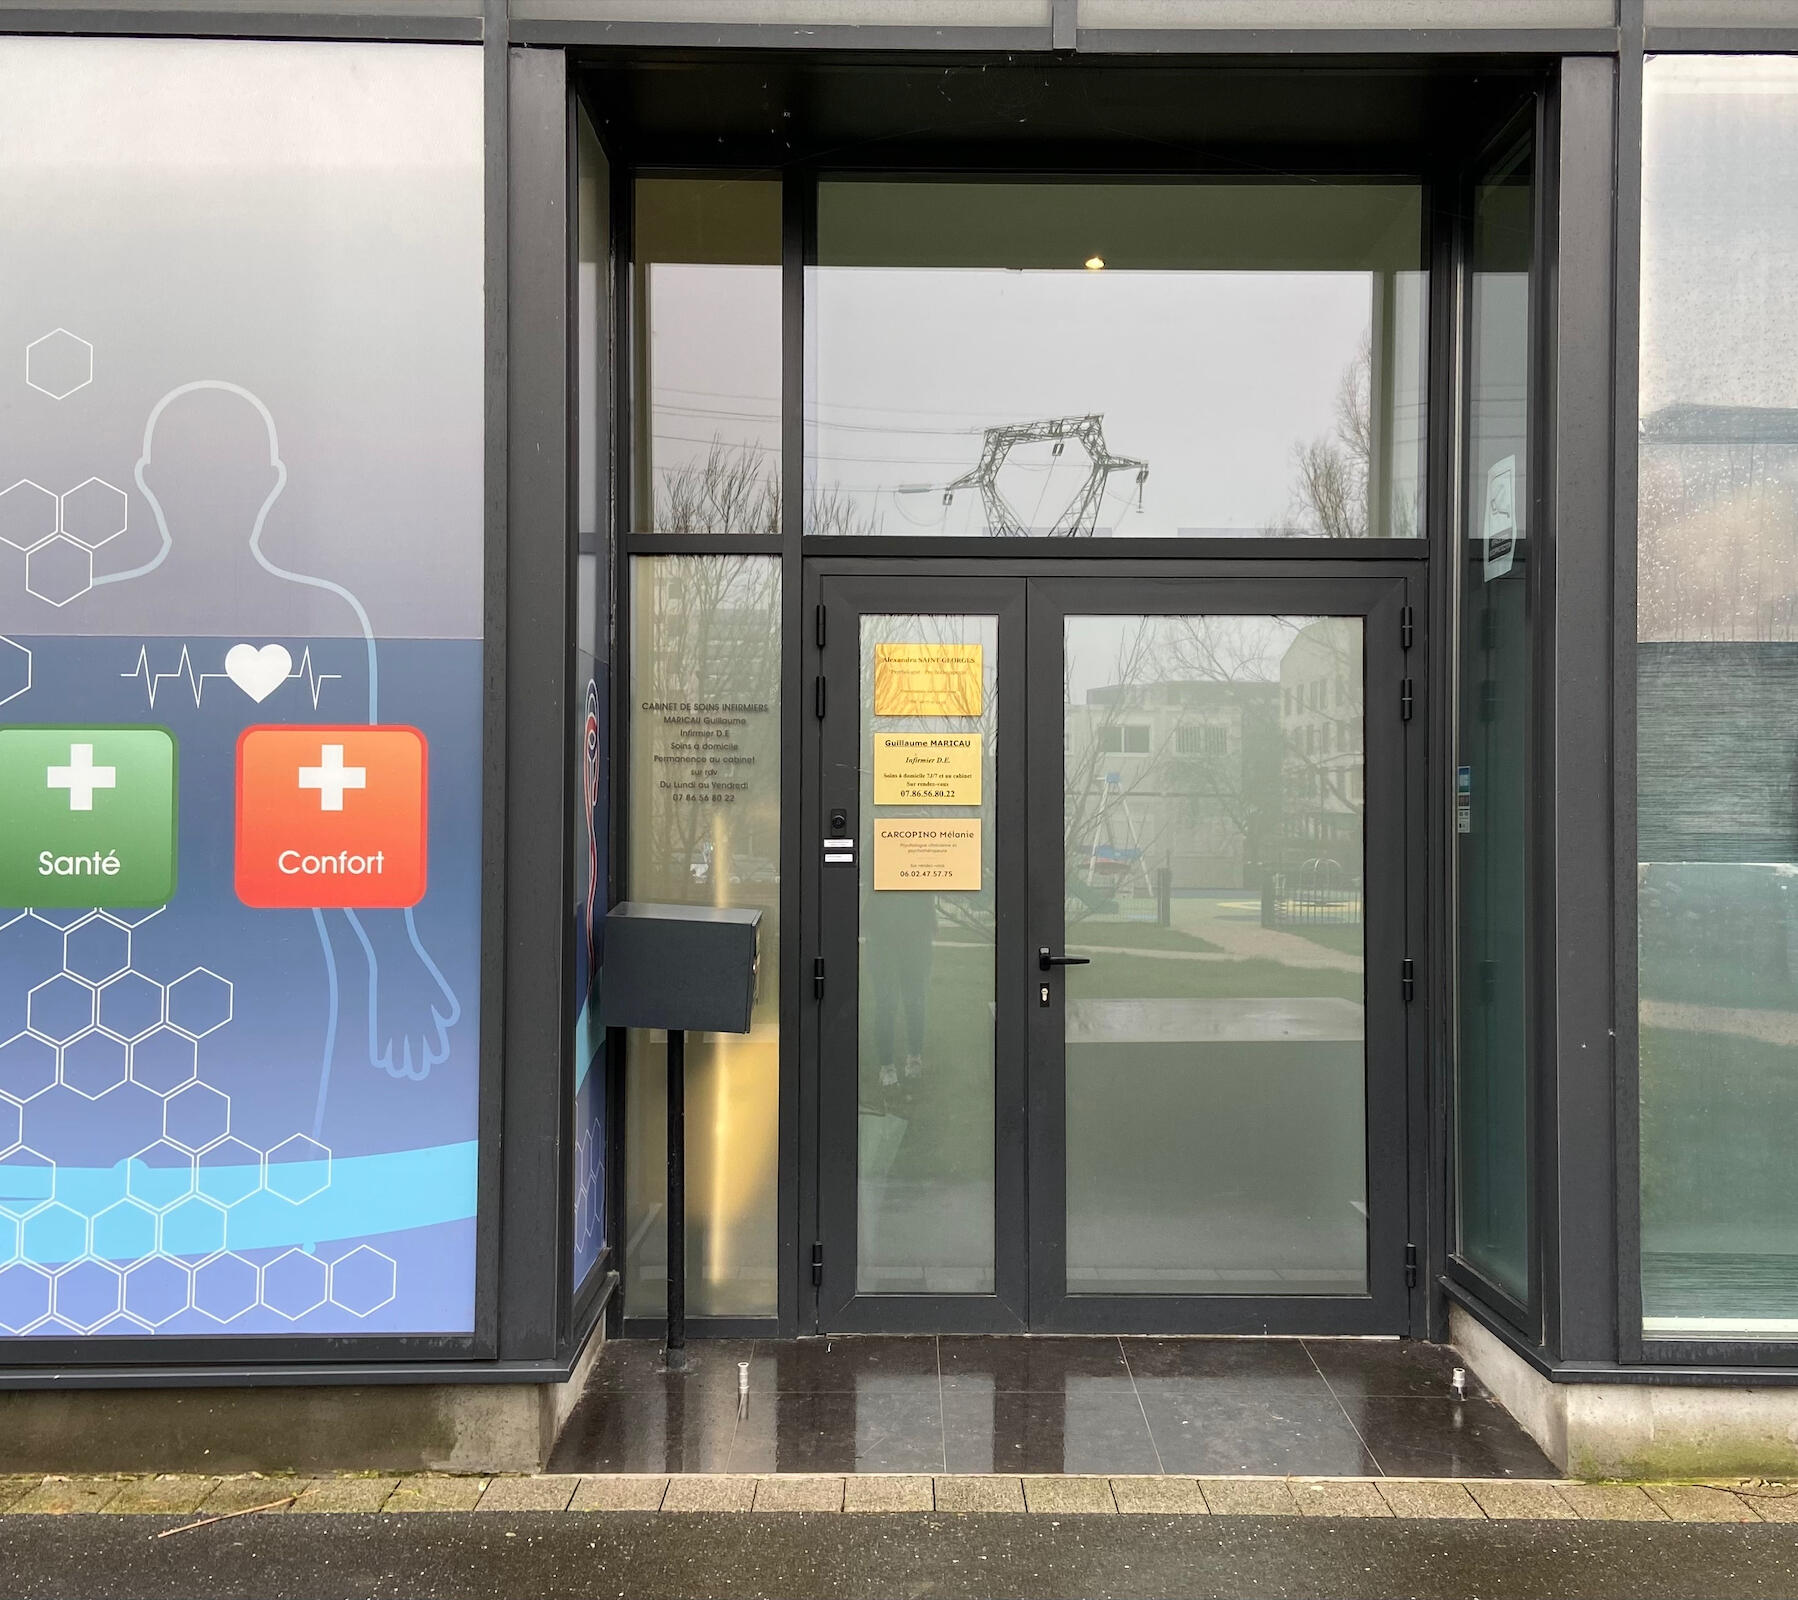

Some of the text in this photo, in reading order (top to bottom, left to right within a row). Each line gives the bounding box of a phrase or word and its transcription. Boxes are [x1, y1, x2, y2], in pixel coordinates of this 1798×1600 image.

[642, 702, 769, 712] CABINET DE SOINS INFIRMIERS
[663, 716, 746, 725] MARICAU Guillaume
[680, 729, 714, 737] Infirmier
[670, 742, 692, 750] Soins
[884, 739, 928, 747] Guillaume
[654, 754, 756, 764] Permanence au cabinet
[905, 756, 935, 764] Infirmier
[704, 768, 718, 776] rdv
[660, 781, 672, 789] Du
[711, 782, 749, 790] Vendredi
[672, 794, 736, 802] 07 86 56 80 22
[900, 790, 956, 798] 07.86.56.80.22
[939, 830, 974, 838] Mélanie
[38, 848, 121, 877] Santé
[277, 849, 384, 876] Confort
[900, 870, 954, 878] 06.02.47.57.75
